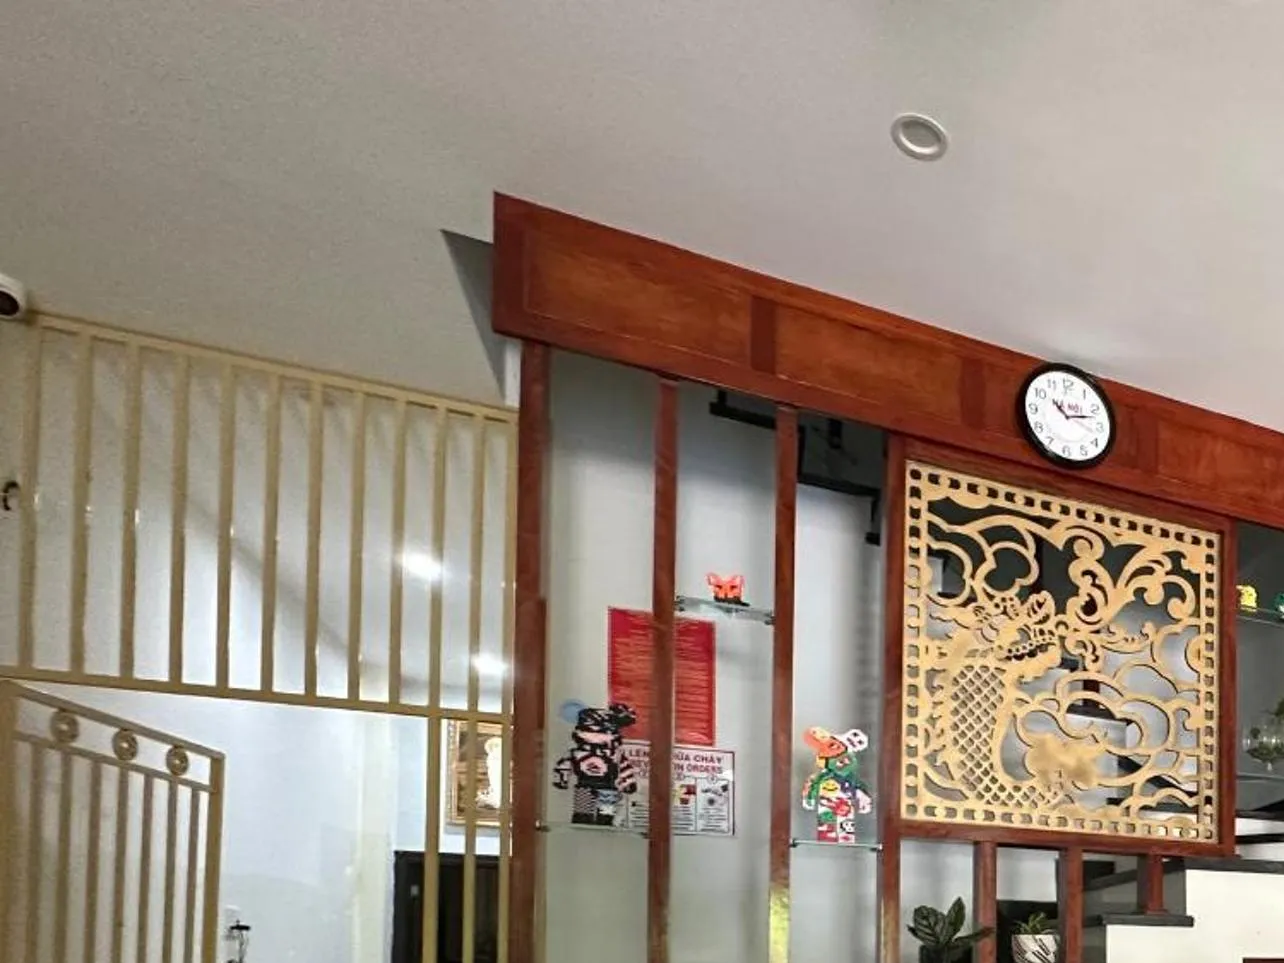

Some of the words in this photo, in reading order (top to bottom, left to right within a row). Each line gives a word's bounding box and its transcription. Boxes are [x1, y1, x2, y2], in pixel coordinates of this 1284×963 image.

[1035, 387, 1047, 399] 10
[1028, 402, 1039, 415] 9
[1090, 403, 1100, 415] 2
[1034, 421, 1044, 434] 8
[1096, 422, 1105, 434] 3
[1045, 436, 1055, 445] 7
[1090, 437, 1099, 448] 4
[1062, 445, 1072, 458] 6
